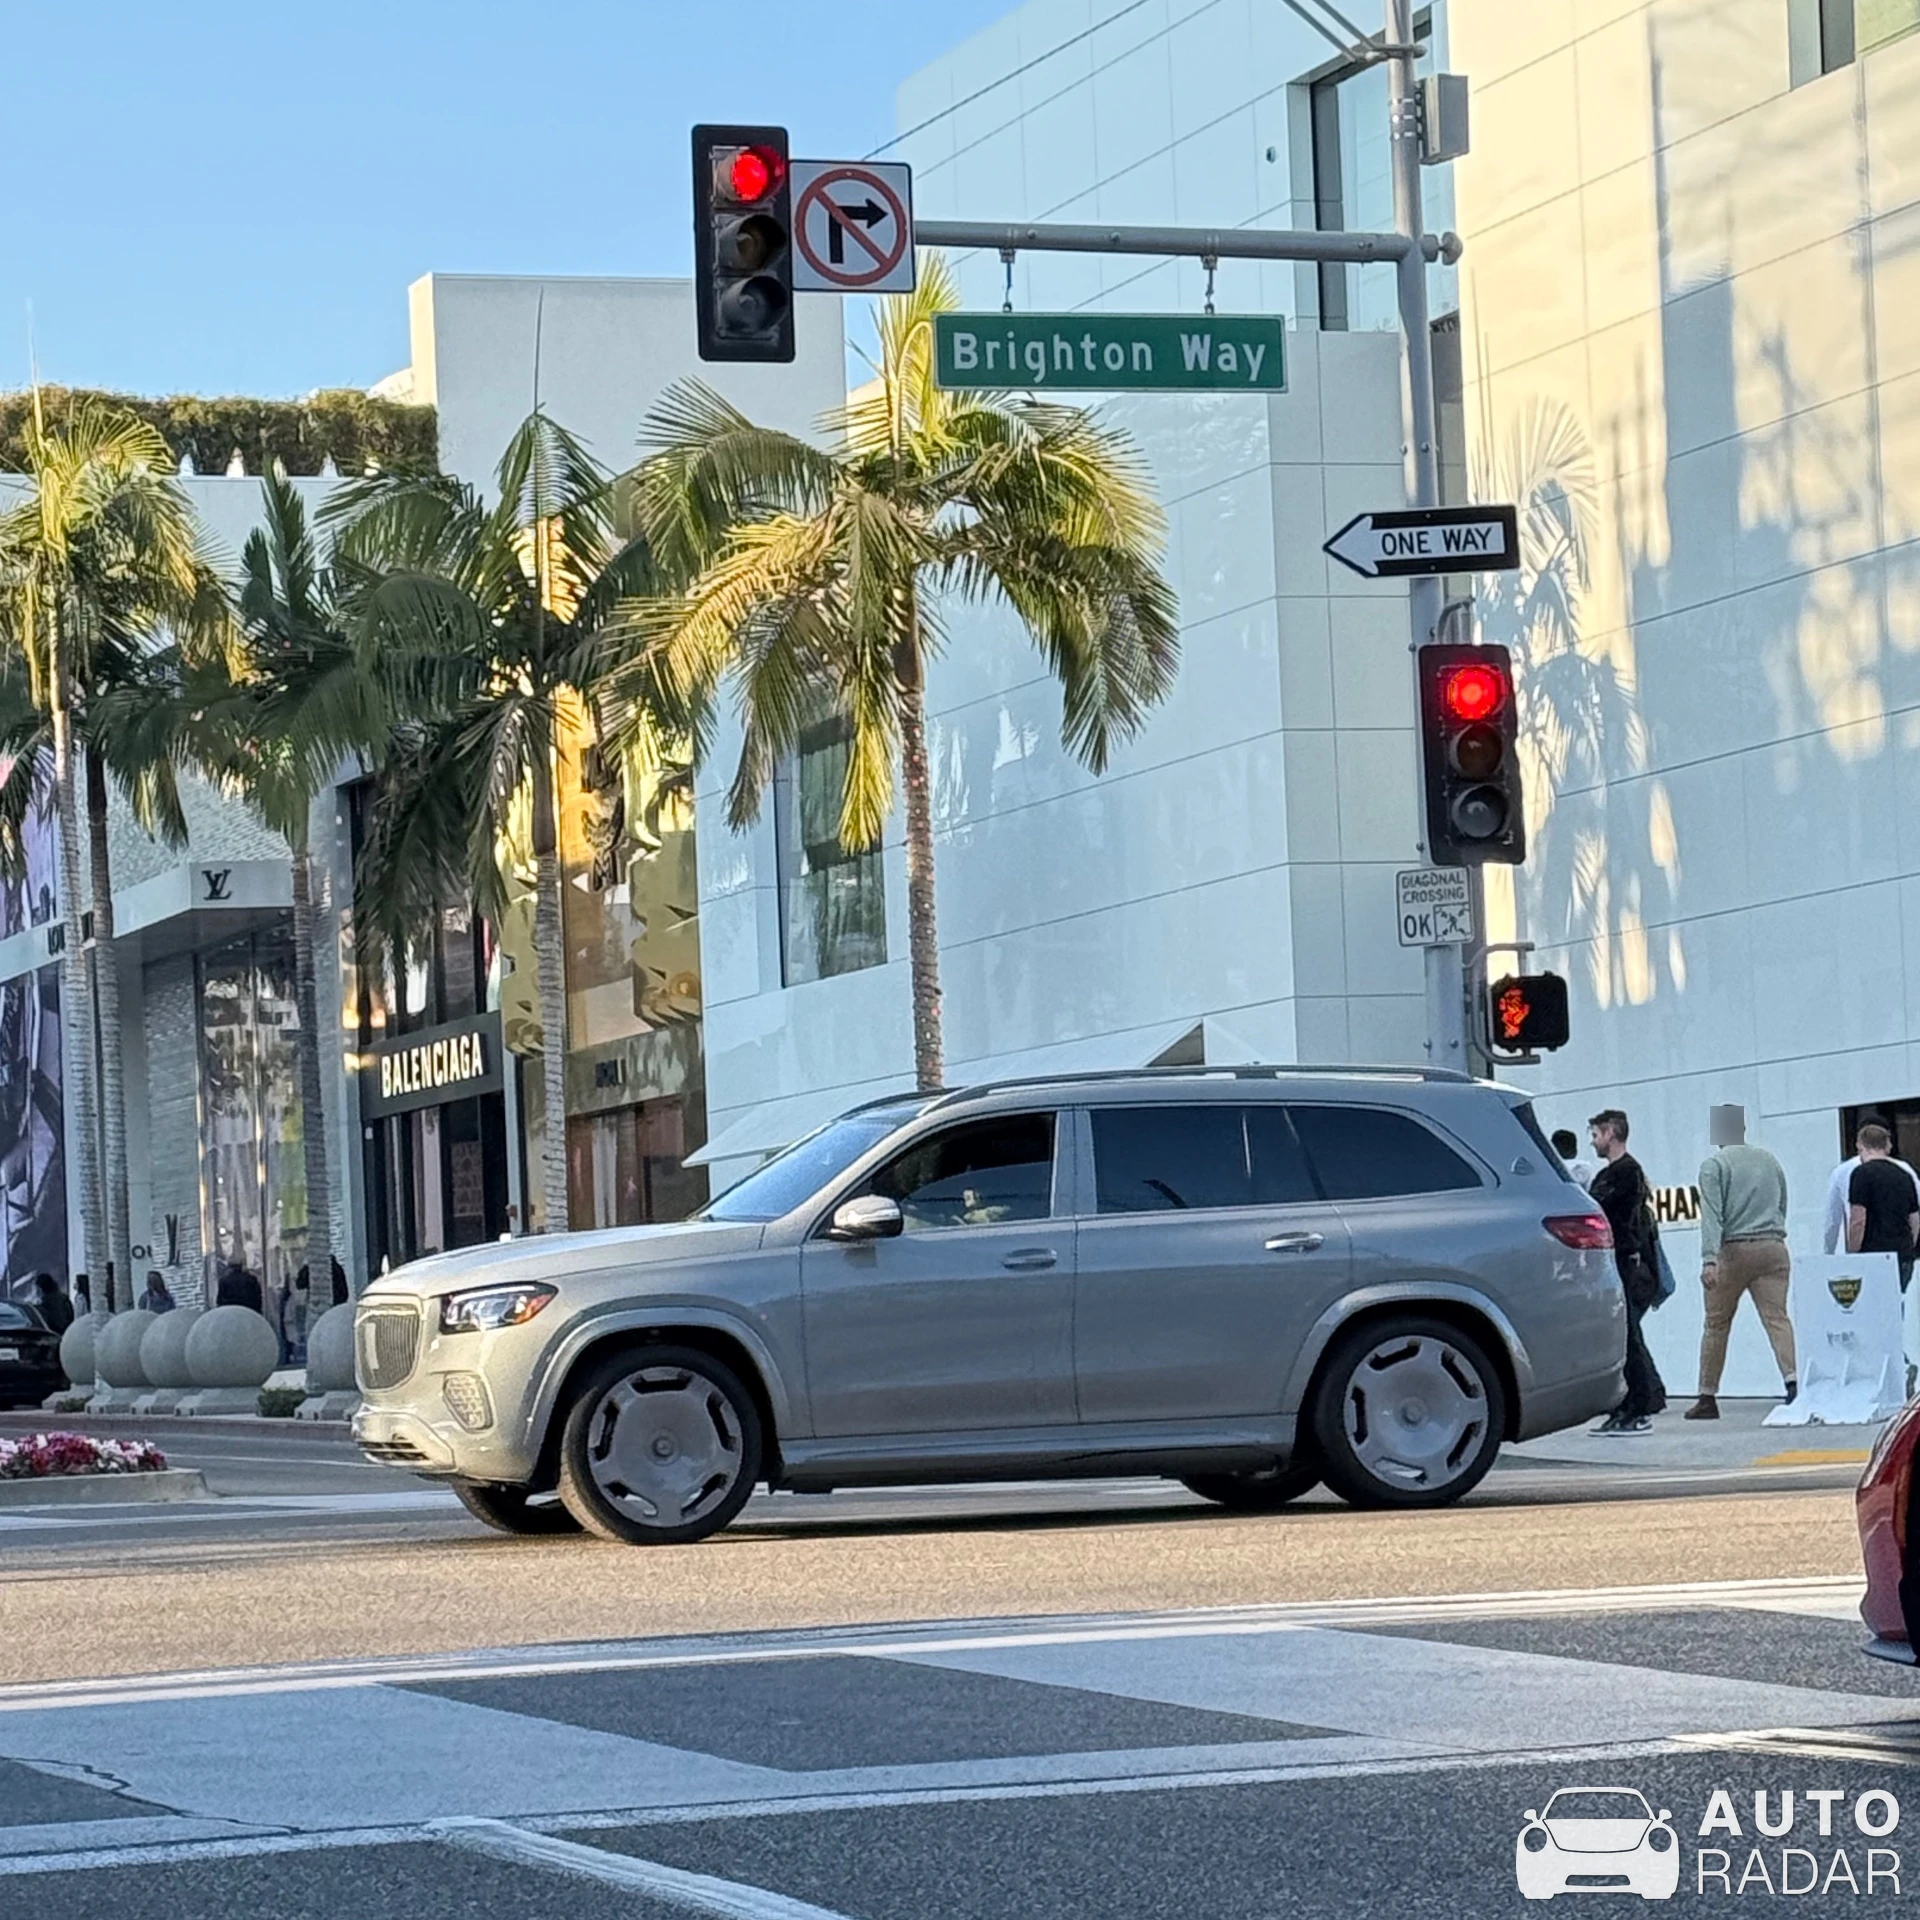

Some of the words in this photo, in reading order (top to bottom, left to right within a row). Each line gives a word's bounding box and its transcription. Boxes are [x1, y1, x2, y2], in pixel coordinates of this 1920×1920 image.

[952, 331, 1154, 383] Brighton
[1179, 333, 1266, 382] Way
[1381, 530, 1432, 556] ONE
[1442, 526, 1493, 552] WAY
[1401, 871, 1465, 889] DIAGONAL
[1402, 886, 1465, 904] CROSSING
[1403, 913, 1432, 938] OK
[381, 1031, 484, 1098] BALENCIAGA
